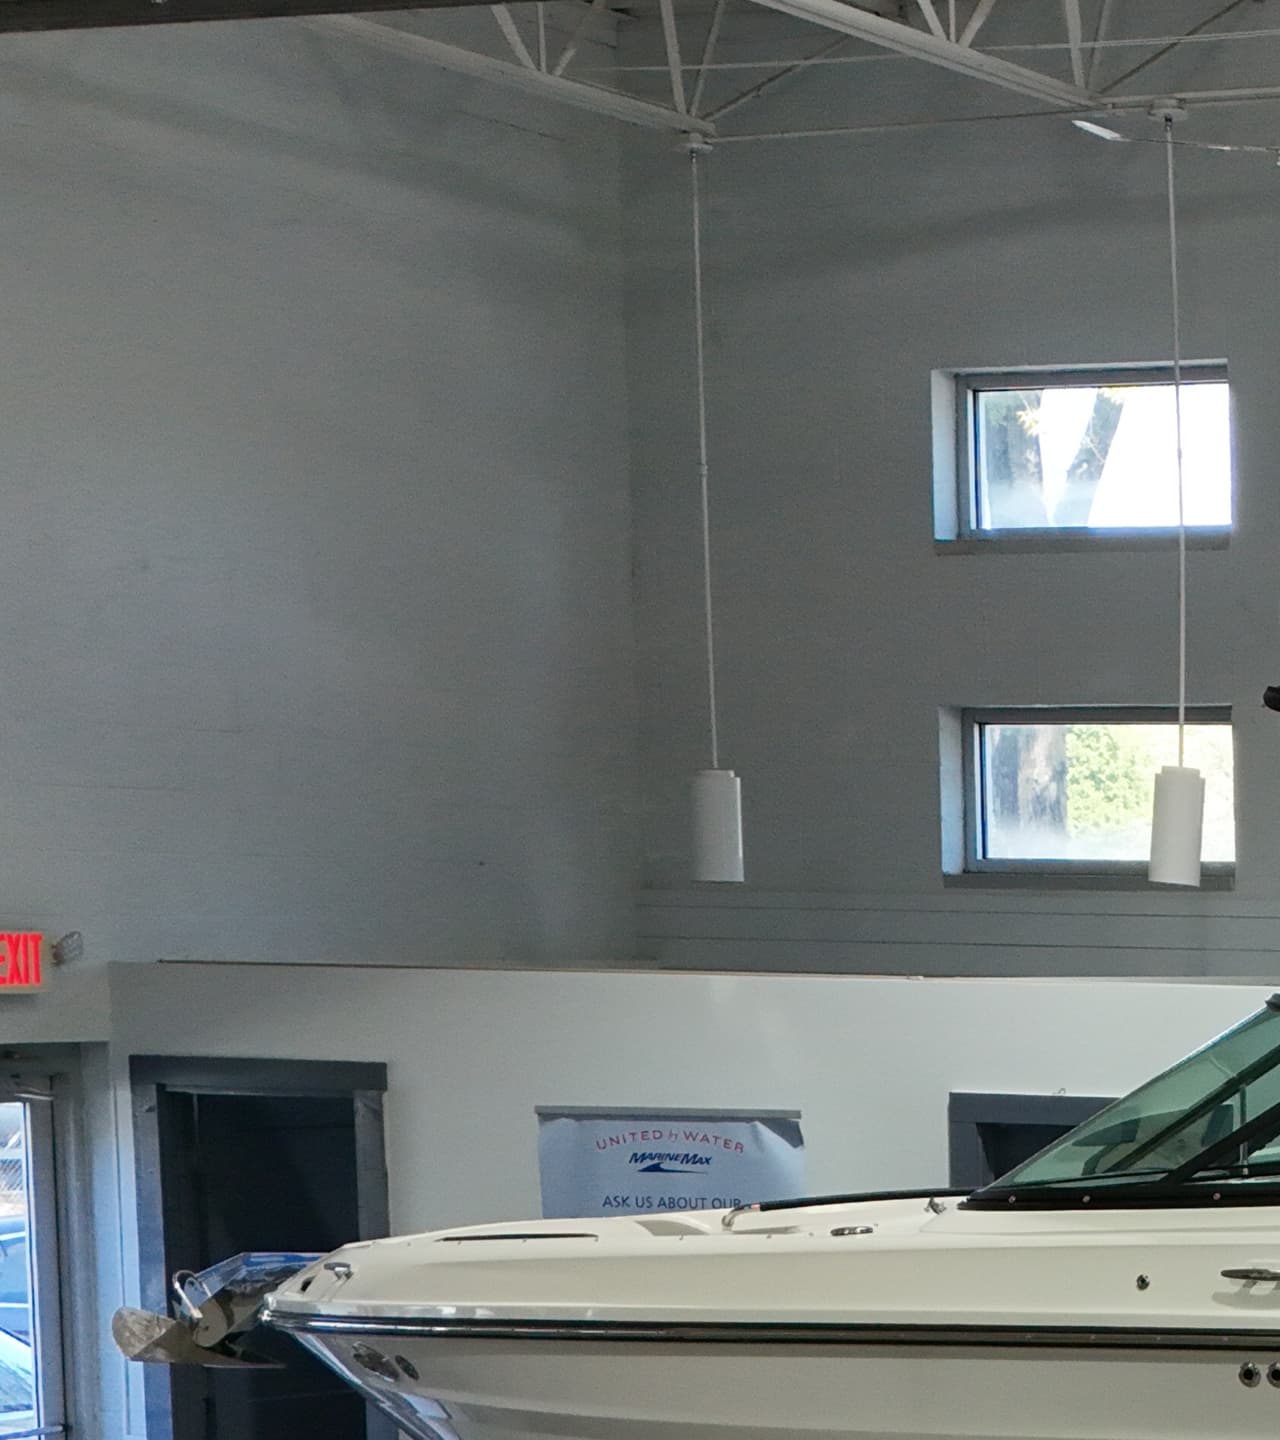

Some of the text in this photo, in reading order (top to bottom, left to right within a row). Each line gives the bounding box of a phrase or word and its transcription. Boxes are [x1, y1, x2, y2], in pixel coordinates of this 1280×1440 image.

[596, 1129, 663, 1151] UNITED
[682, 1130, 745, 1154] WATER
[602, 1196, 741, 1210] ASK US ABOUT OUR
